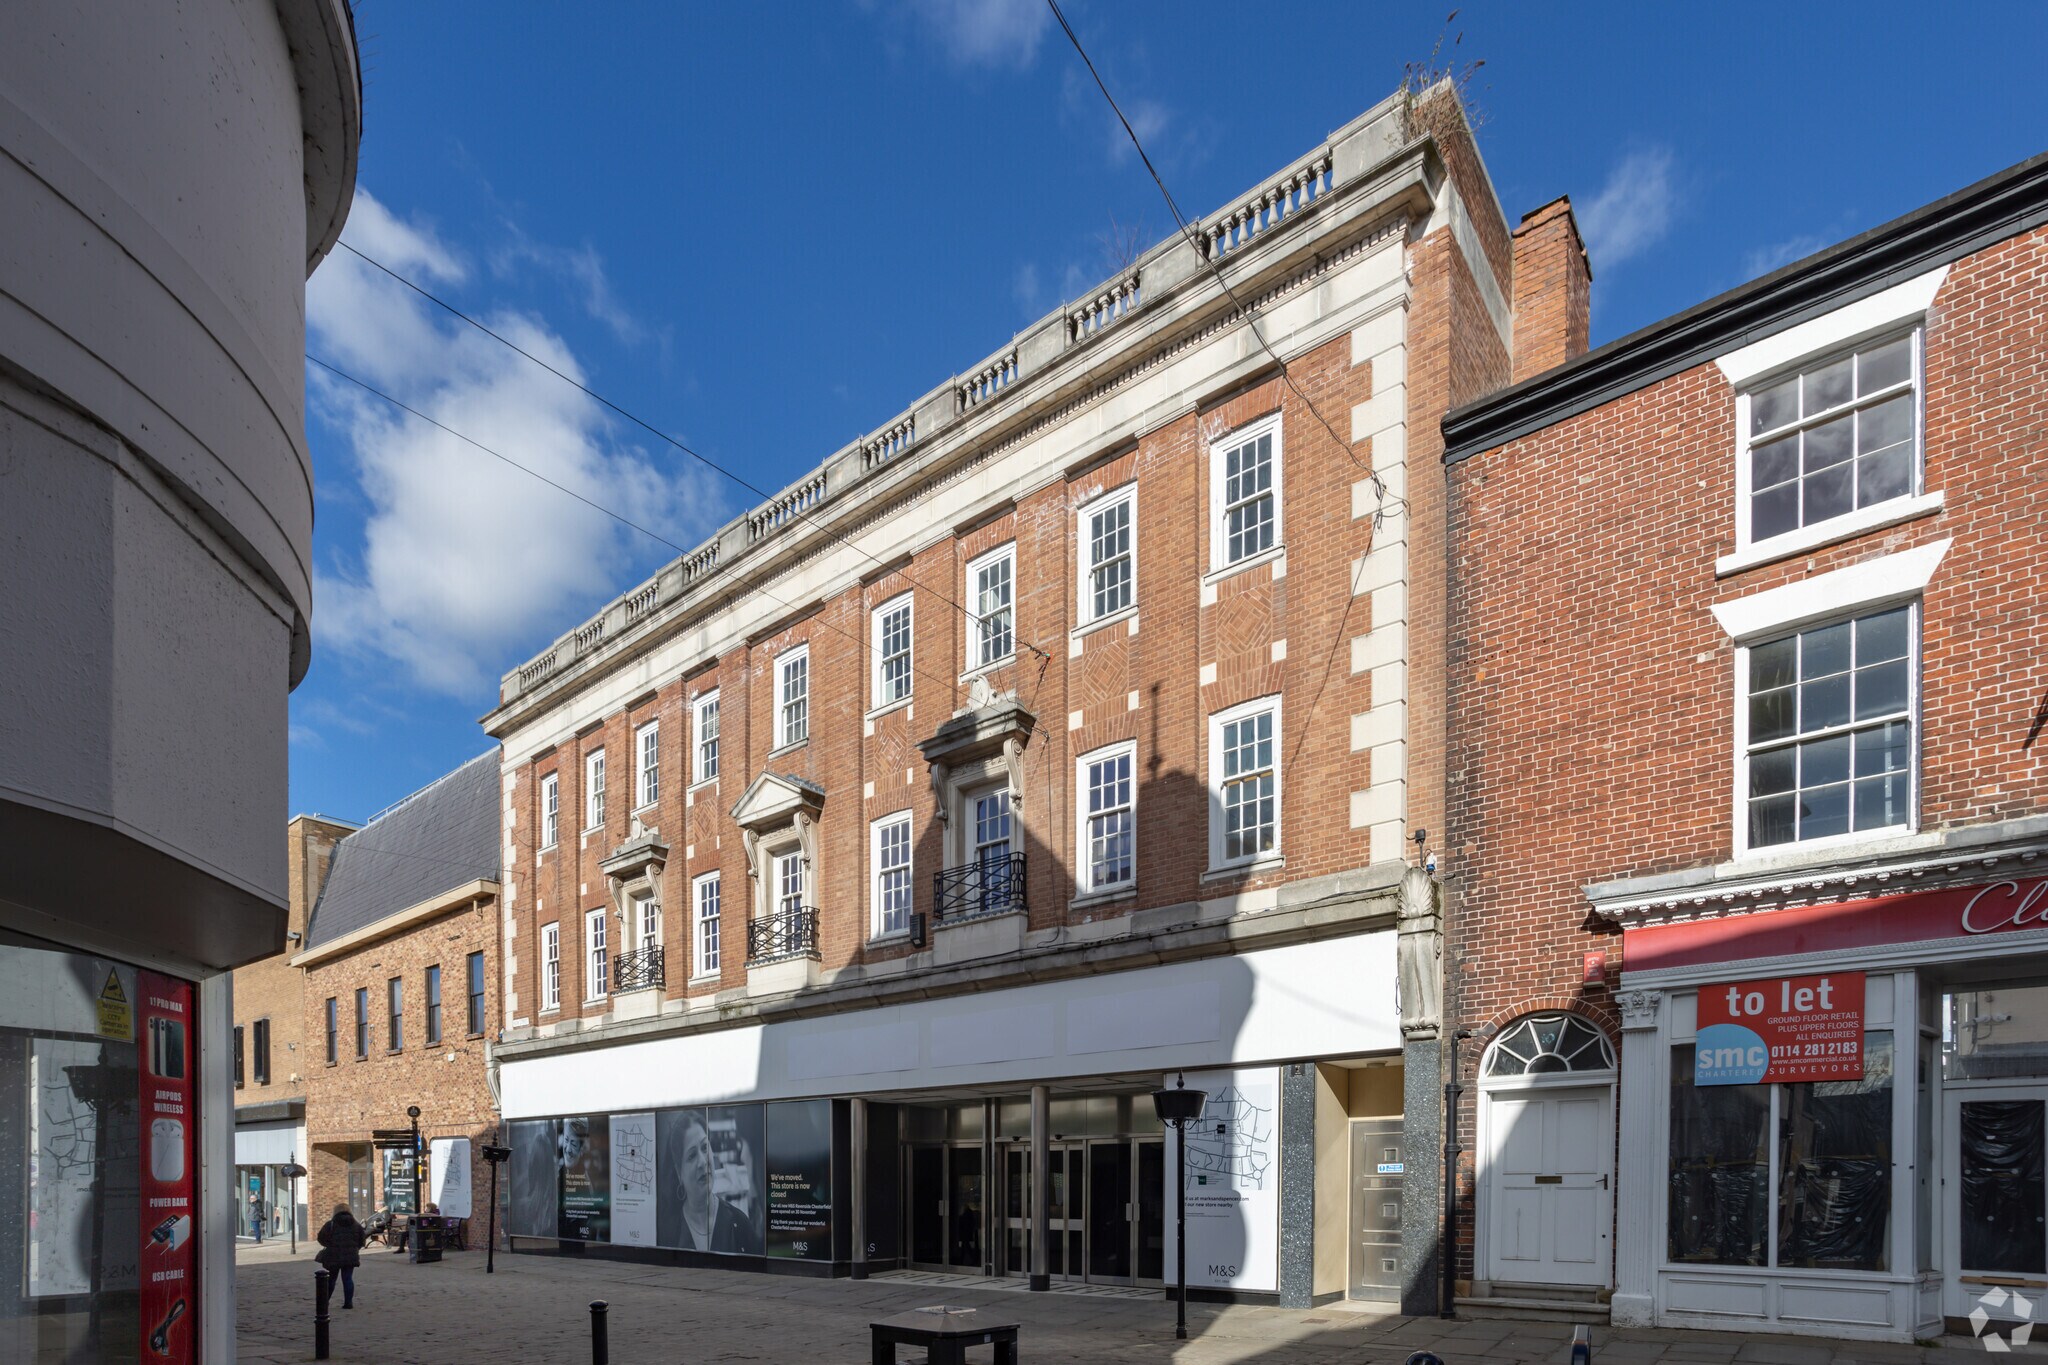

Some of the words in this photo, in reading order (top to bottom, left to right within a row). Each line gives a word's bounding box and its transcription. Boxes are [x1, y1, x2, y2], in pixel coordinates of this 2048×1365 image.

[1726, 986, 1765, 1017] to
[1781, 978, 1833, 1013] let
[149, 996, 156, 1006] 11
[157, 997, 169, 1009] PRO
[169, 1001, 183, 1013] MAX
[1767, 1015, 1801, 1025] GROUND
[1802, 1013, 1828, 1022] FLOOR
[1830, 1011, 1859, 1021] RETAIL
[1777, 1025, 1797, 1033] PLUS
[1799, 1023, 1825, 1032] UPPER
[1827, 1021, 1859, 1031] FLOORS
[1795, 1032, 1809, 1041] ALL
[1811, 1031, 1857, 1041] ENQUIRIES
[1698, 1046, 1764, 1069] smc
[1771, 1045, 1800, 1058] 0114
[1772, 1055, 1857, 1066] www.smcommercial.co.uk
[1698, 1069, 1763, 1078] CHARTERED
[1769, 1064, 1860, 1075] SURVEYORS
[155, 1089, 182, 1102] AIRPODS
[153, 1102, 184, 1114] WIRELESS
[785, 1173, 803, 1181] moved.
[781, 1182, 794, 1190] store
[795, 1182, 799, 1190] is
[771, 1190, 787, 1198] closed
[150, 1198, 172, 1208] POWER
[172, 1197, 188, 1207] BANK
[792, 1241, 808, 1251] M&S
[152, 1270, 165, 1282] USB
[165, 1268, 184, 1280] CABLE
[1208, 1264, 1236, 1278] M&S
